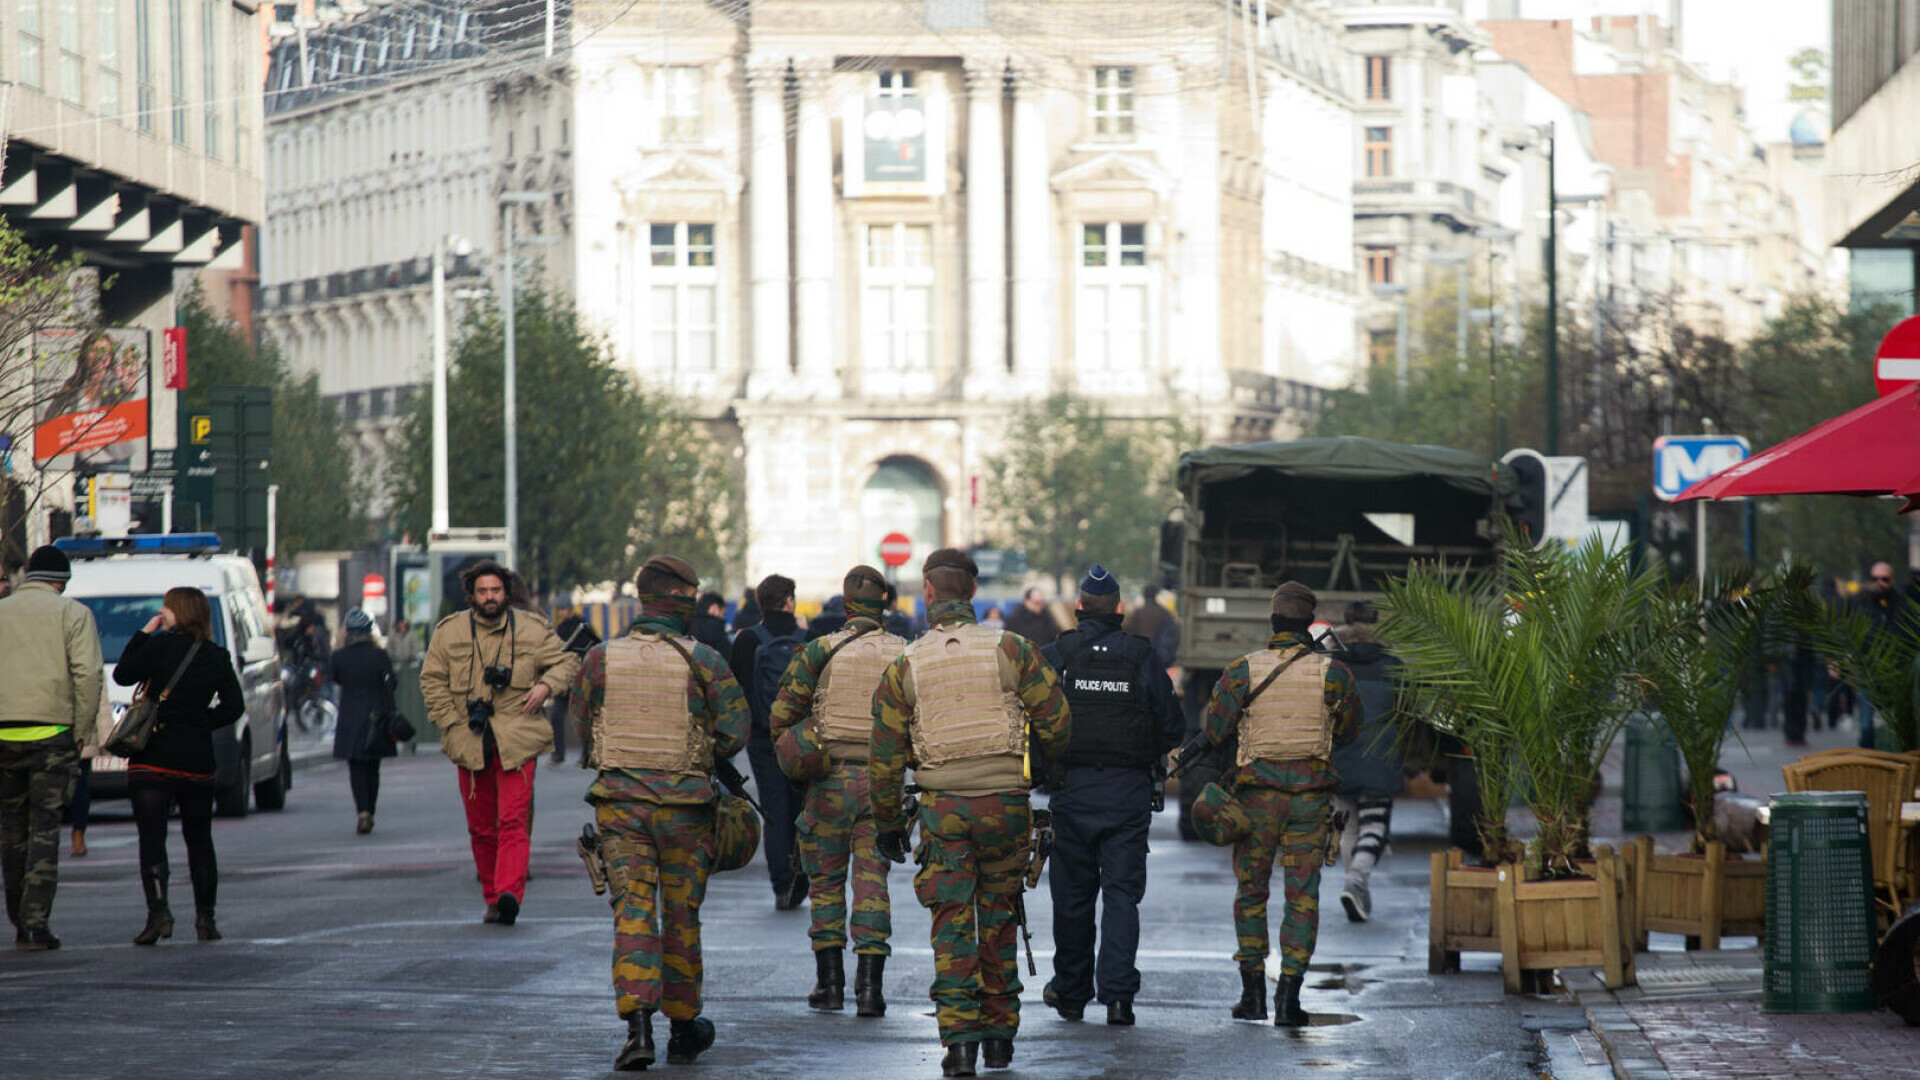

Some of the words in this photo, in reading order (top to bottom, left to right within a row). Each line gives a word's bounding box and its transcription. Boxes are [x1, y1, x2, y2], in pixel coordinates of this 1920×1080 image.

[197, 419, 211, 440] P
[1661, 445, 1743, 491] M
[1075, 680, 1129, 692] POLICE/POLITIE
